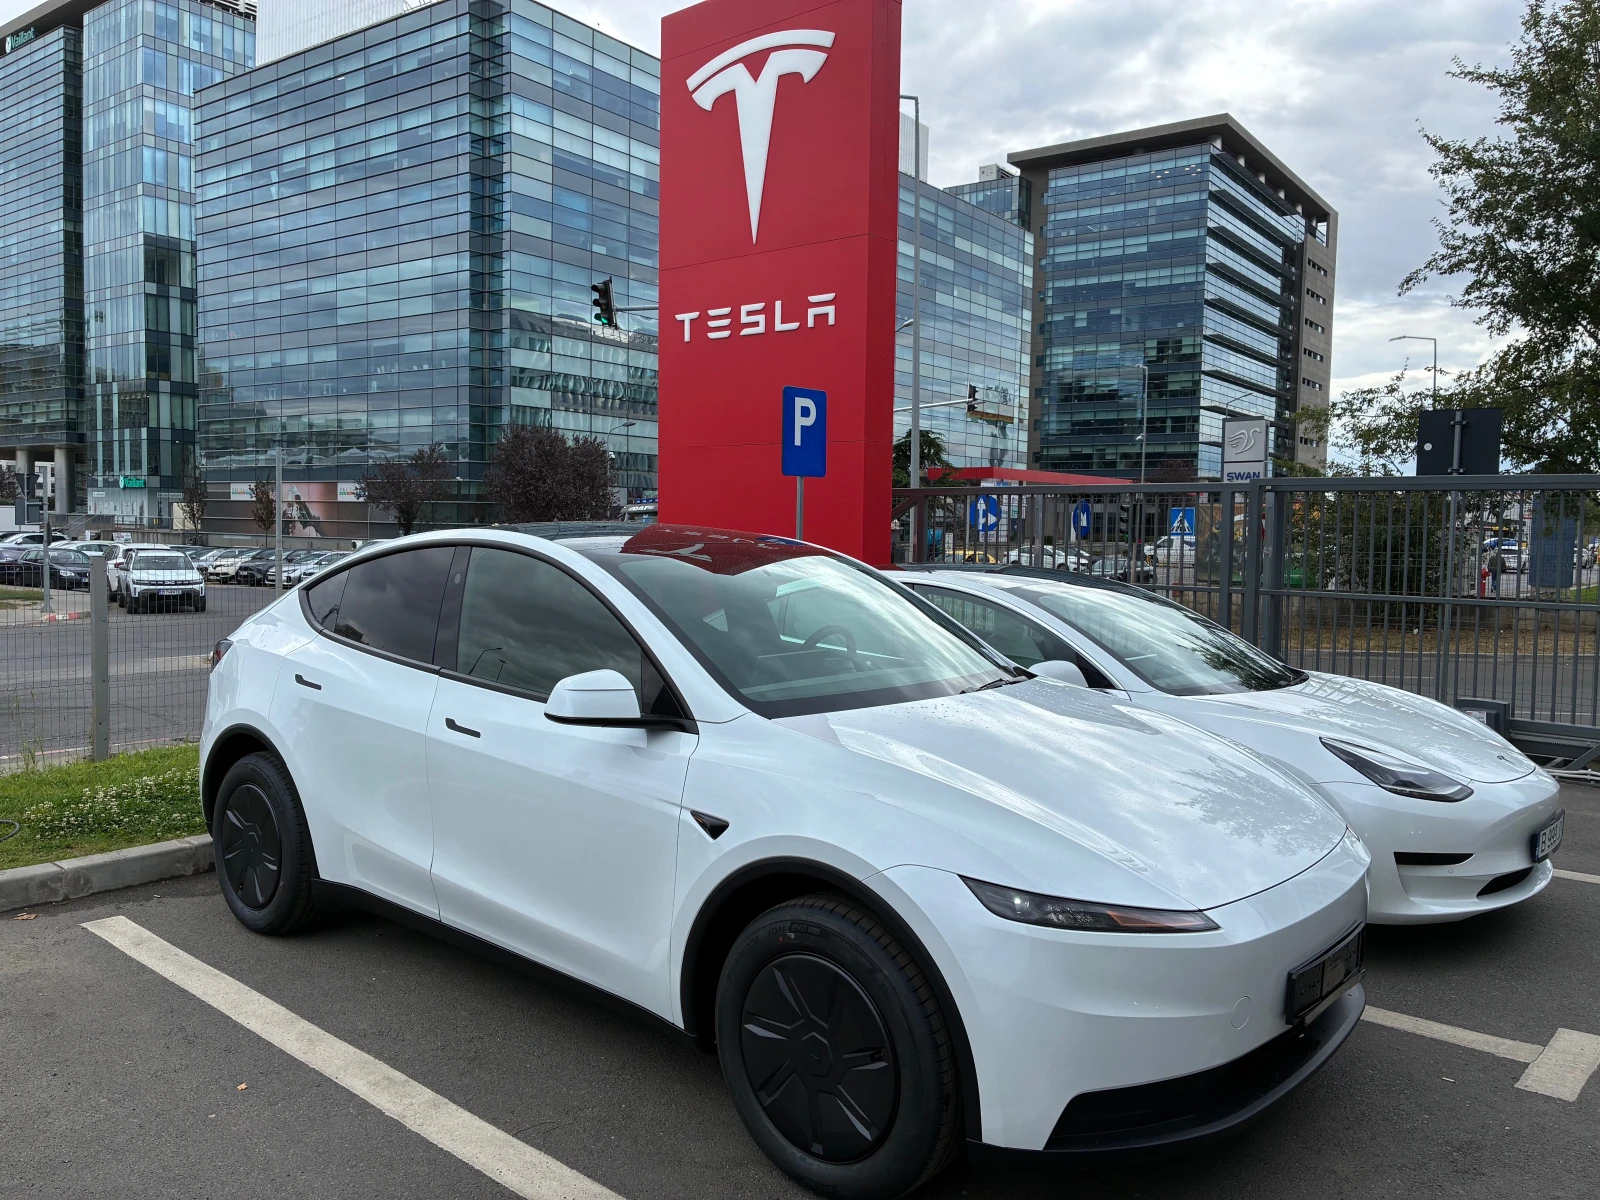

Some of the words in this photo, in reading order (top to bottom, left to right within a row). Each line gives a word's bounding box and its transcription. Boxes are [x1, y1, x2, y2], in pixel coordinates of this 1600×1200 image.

[11, 27, 35, 48] Vaillant
[674, 292, 836, 343] TESLA
[794, 396, 817, 447] P
[125, 478, 145, 488] Vaillant
[1227, 472, 1260, 481] SWAN
[1541, 831, 1547, 853] B
